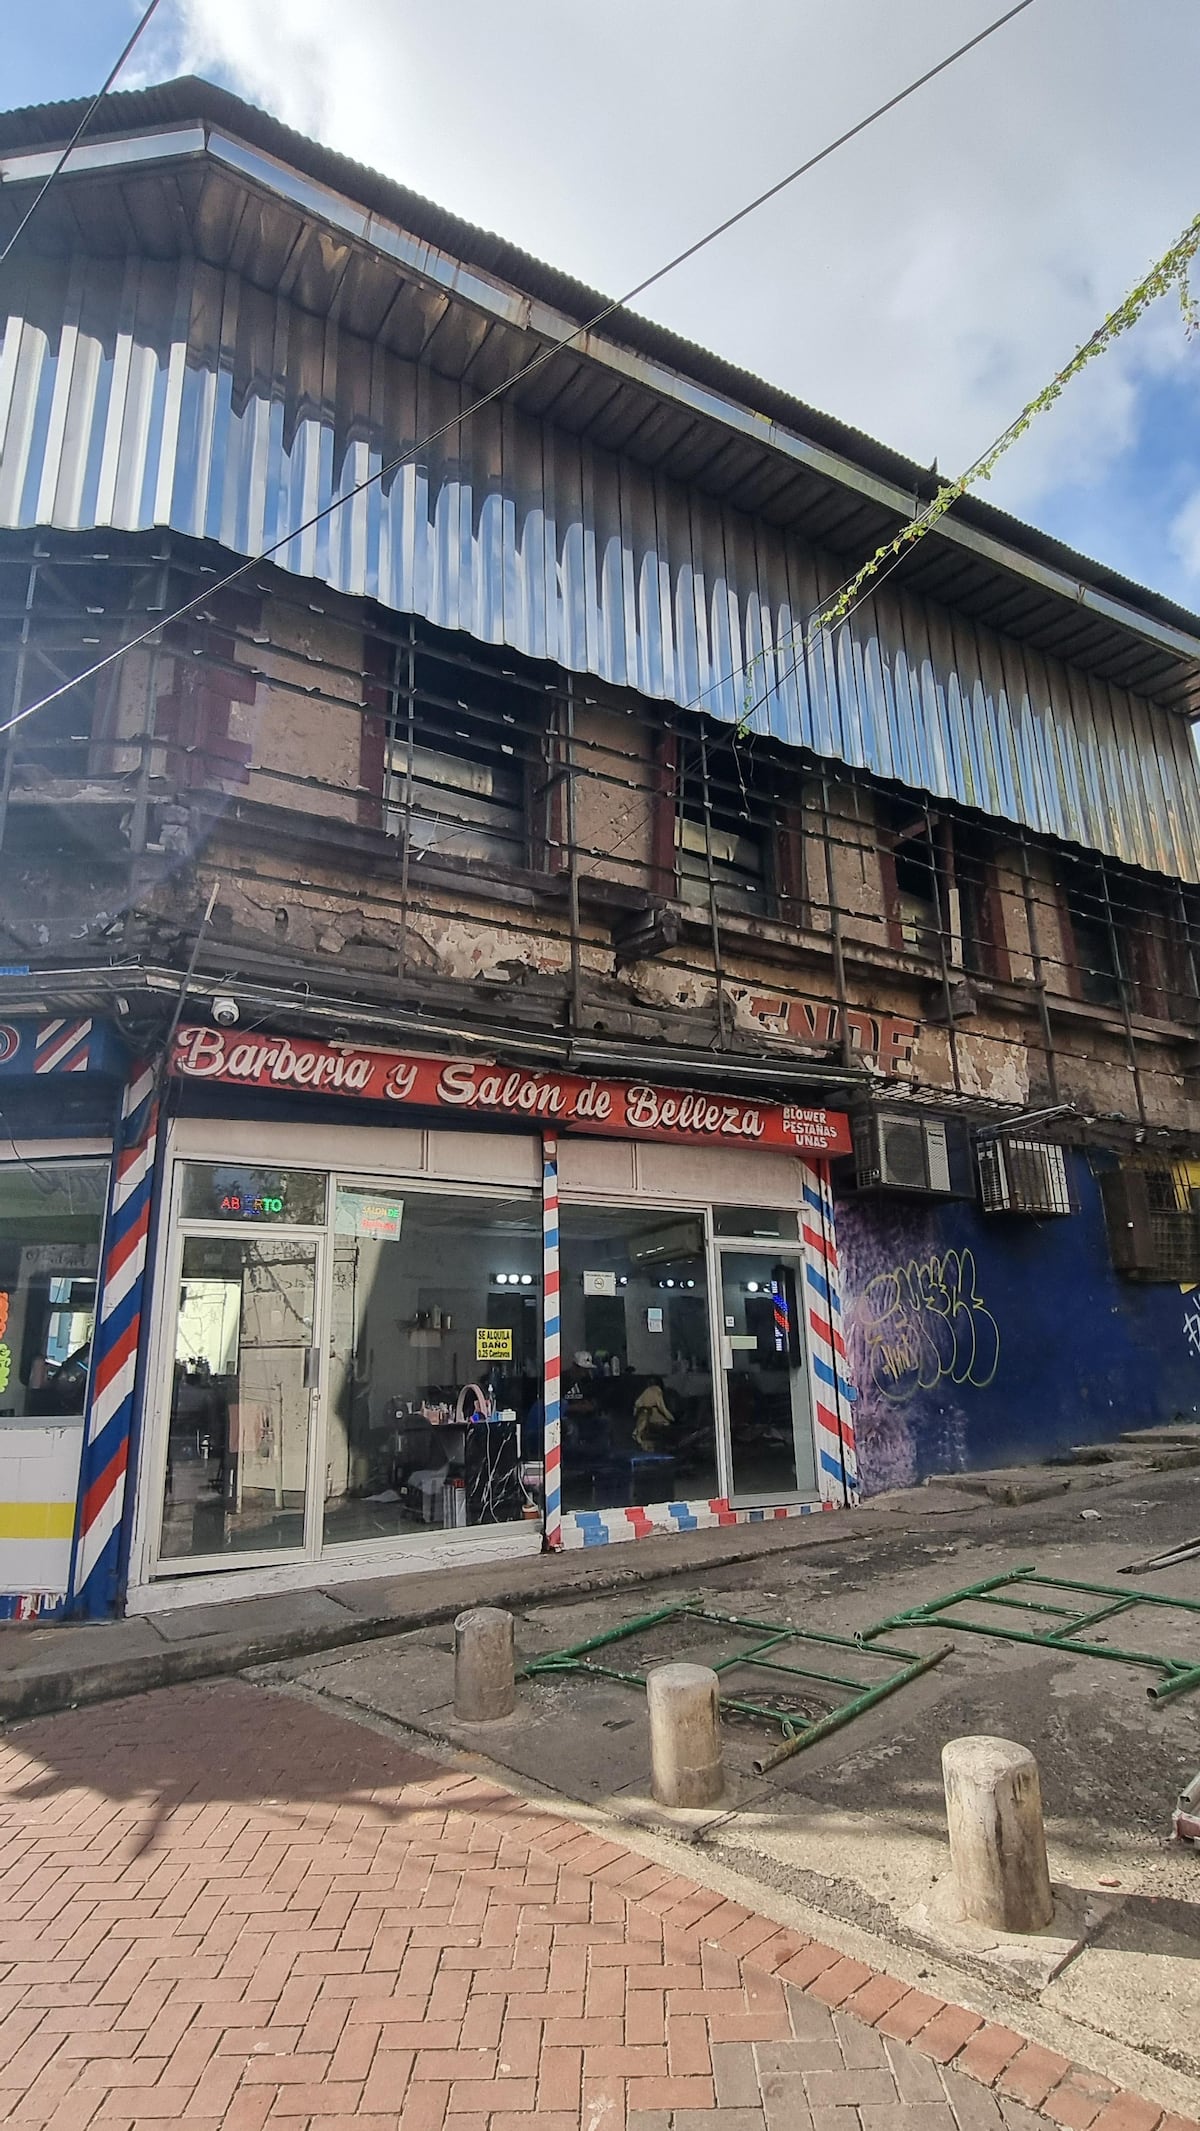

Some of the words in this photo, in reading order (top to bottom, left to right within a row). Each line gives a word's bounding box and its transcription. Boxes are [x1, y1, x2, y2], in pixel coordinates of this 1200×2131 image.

[177, 1027, 375, 1089] Barbería
[384, 1063, 418, 1099] y
[436, 1063, 566, 1113] Salón
[567, 1081, 613, 1119] de
[625, 1086, 765, 1137] Belleza
[783, 1107, 826, 1124] BLOWER
[387, 1208, 399, 1218] DE
[478, 1330, 486, 1340] SE
[487, 1330, 510, 1340] ALQUILA
[481, 1340, 508, 1349] BAÑO
